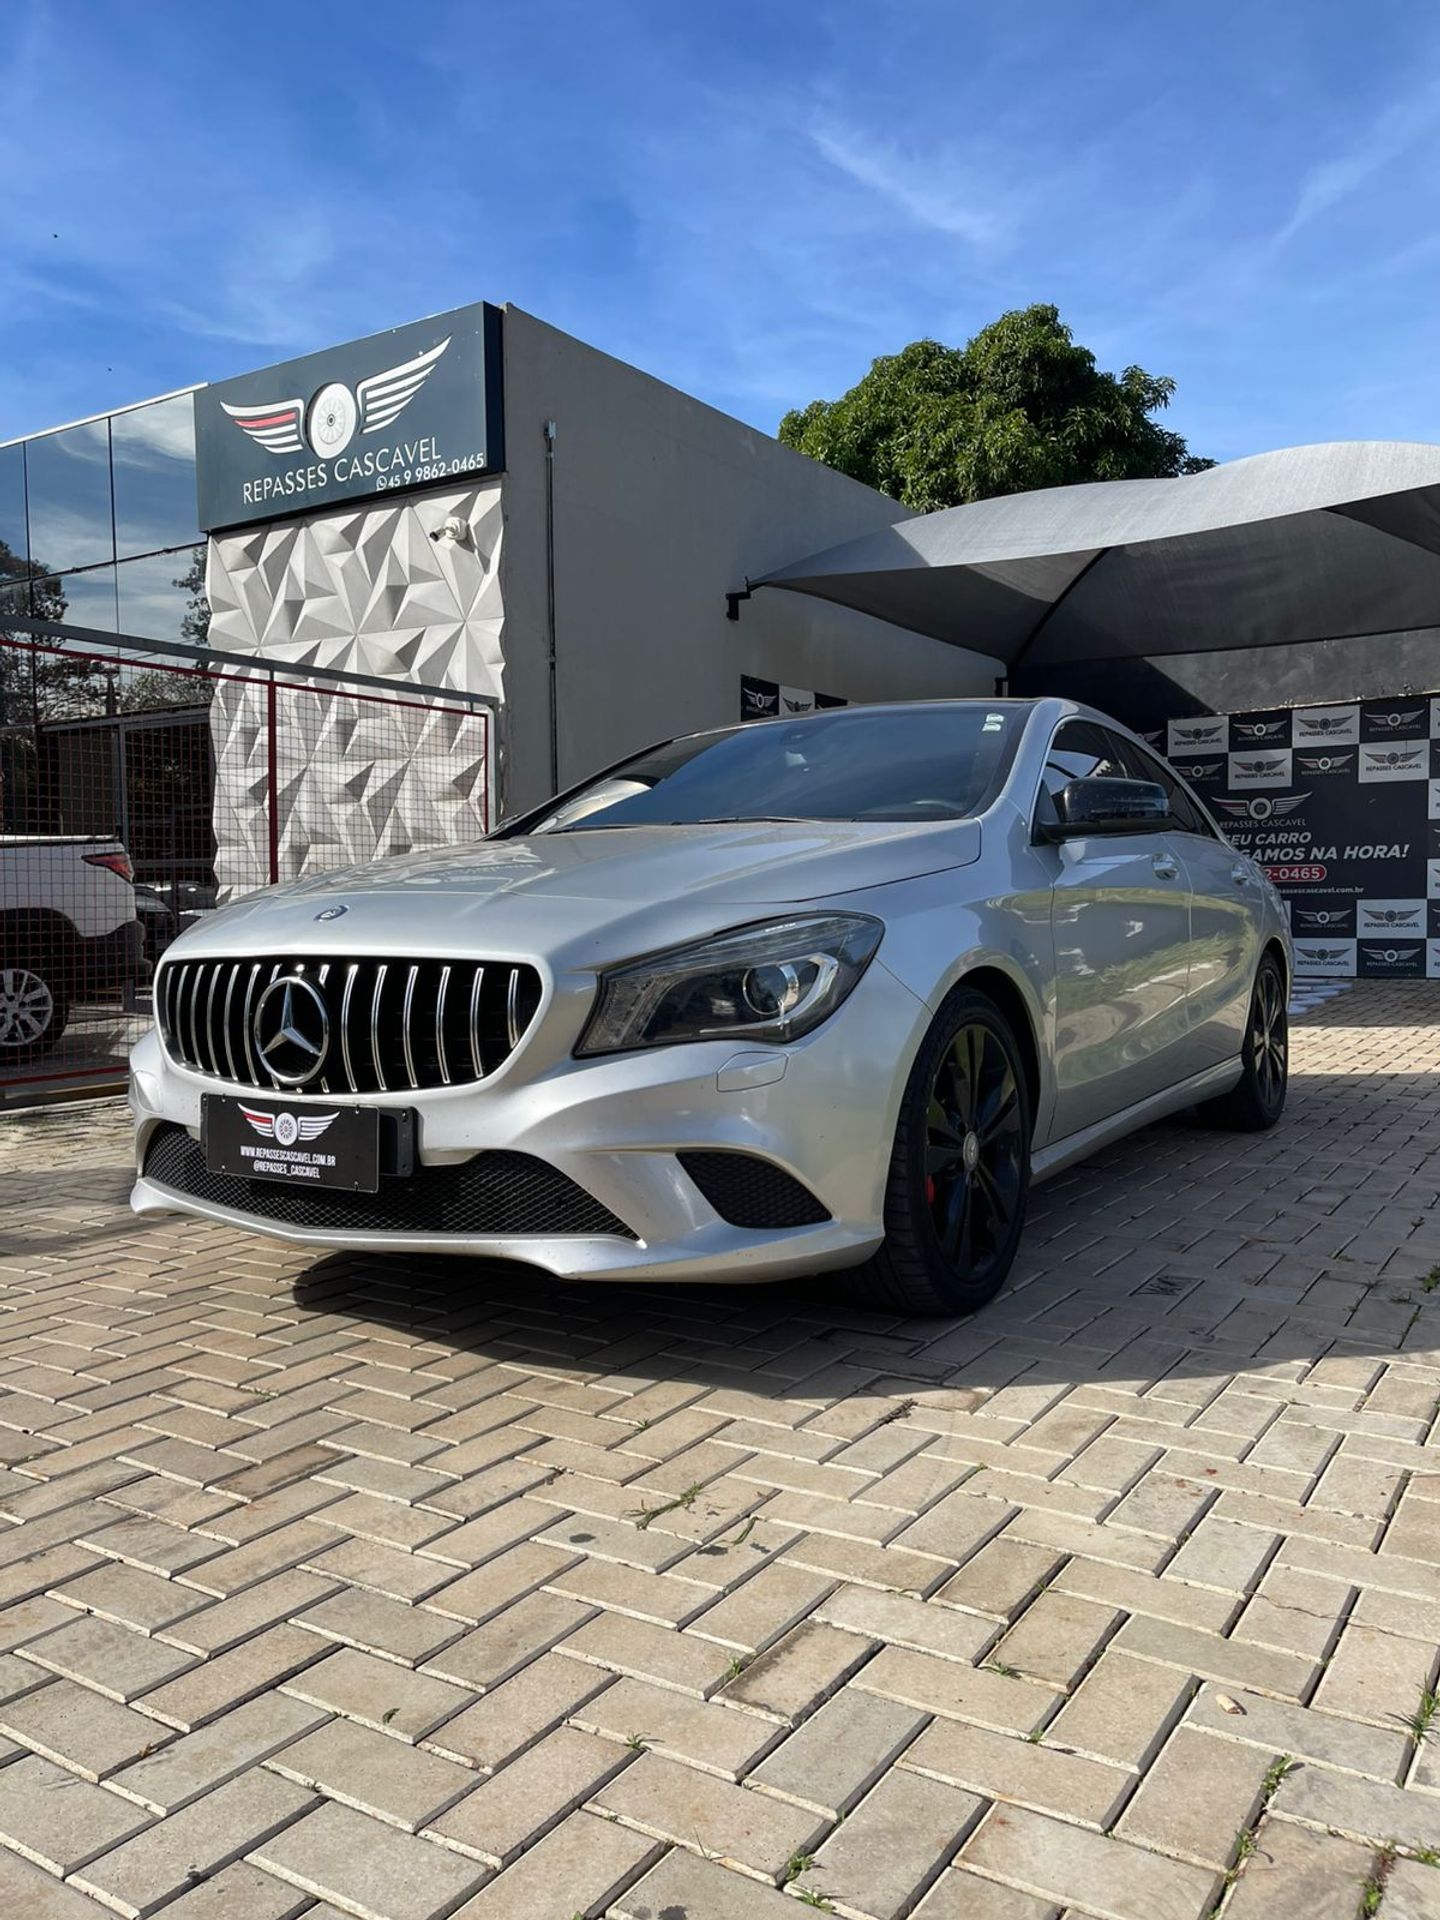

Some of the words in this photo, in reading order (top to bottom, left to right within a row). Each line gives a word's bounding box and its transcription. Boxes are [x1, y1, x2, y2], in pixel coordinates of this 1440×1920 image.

[243, 463, 327, 504] REPASSES
[334, 436, 442, 483] CASCAVEL
[388, 474, 400, 487] 45
[404, 470, 411, 485] 9
[415, 452, 484, 482] 9862-0465
[1261, 818, 1307, 827] CASCAVEL
[1255, 832, 1312, 845] CARRO
[1310, 846, 1338, 860] NA
[1343, 844, 1410, 859] HORA!
[240, 1145, 336, 1167] WWW.REPASSESCASCAVEL.COM.BR
[253, 1160, 320, 1178] @REPASSES_CASCAVEL
